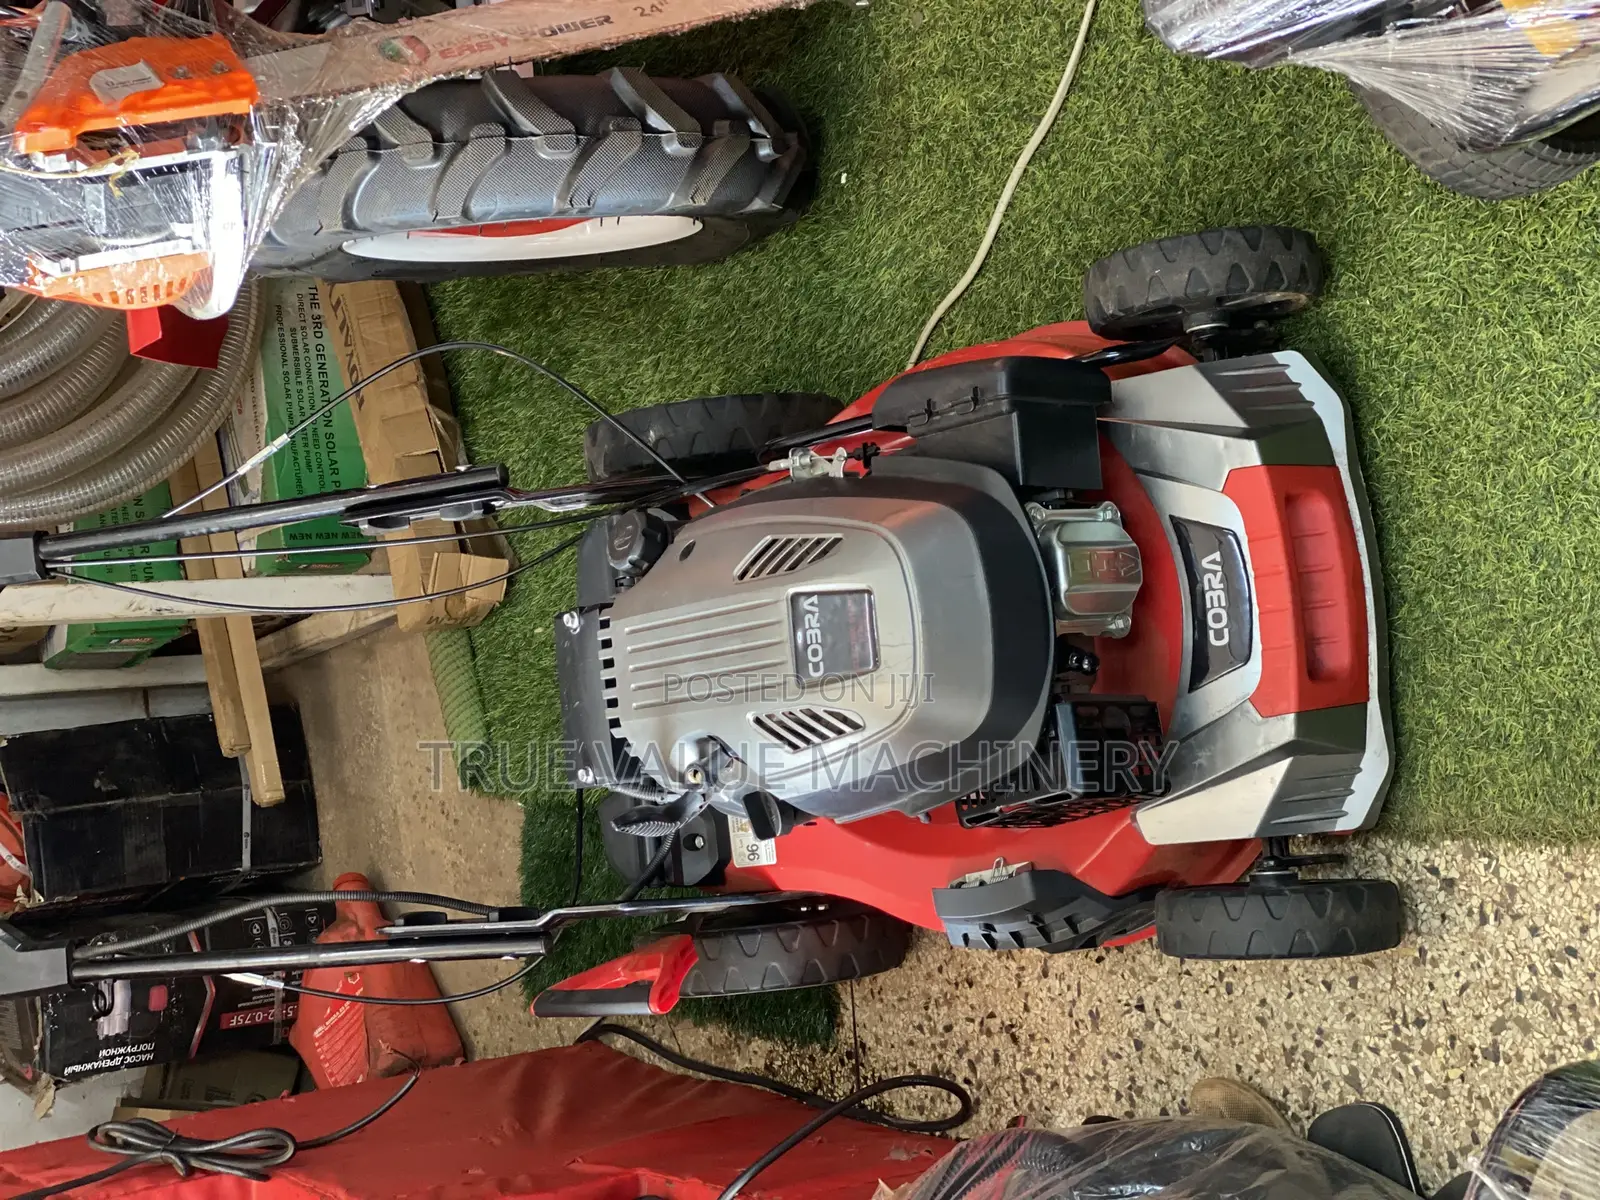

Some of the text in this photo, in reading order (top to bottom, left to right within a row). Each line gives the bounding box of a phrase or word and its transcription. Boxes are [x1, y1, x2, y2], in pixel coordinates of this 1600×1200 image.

[297, 293, 306, 323] DIRECT
[308, 285, 319, 310] THE
[275, 304, 290, 368] PROFESSIONAL
[300, 326, 310, 354] SOLAR
[311, 314, 324, 340] 3RD
[283, 370, 292, 400] SOLAR
[304, 356, 316, 411] CONNECTION
[315, 343, 333, 428] GENERATON
[285, 401, 294, 425] PUMP
[290, 327, 313, 474] SUBMERSIBLE SOLAR ATER PUMP
[251, 396, 261, 452] GENERATI
[311, 427, 320, 449] NEED
[325, 432, 340, 476] SOLAR
[315, 452, 326, 491] CONTROL
[289, 531, 364, 541] NEW NEW NEW
[1201, 551, 1229, 646] COBRA
[803, 594, 824, 677] COBRA
[746, 844, 760, 861] 96
[229, 1005, 298, 1026] .5-2-0.75F
[63, 1053, 154, 1076] НАСОС ДРЕНАЖНЫЙ
[98, 1042, 155, 1058] ПОГРУЖНОЙ
